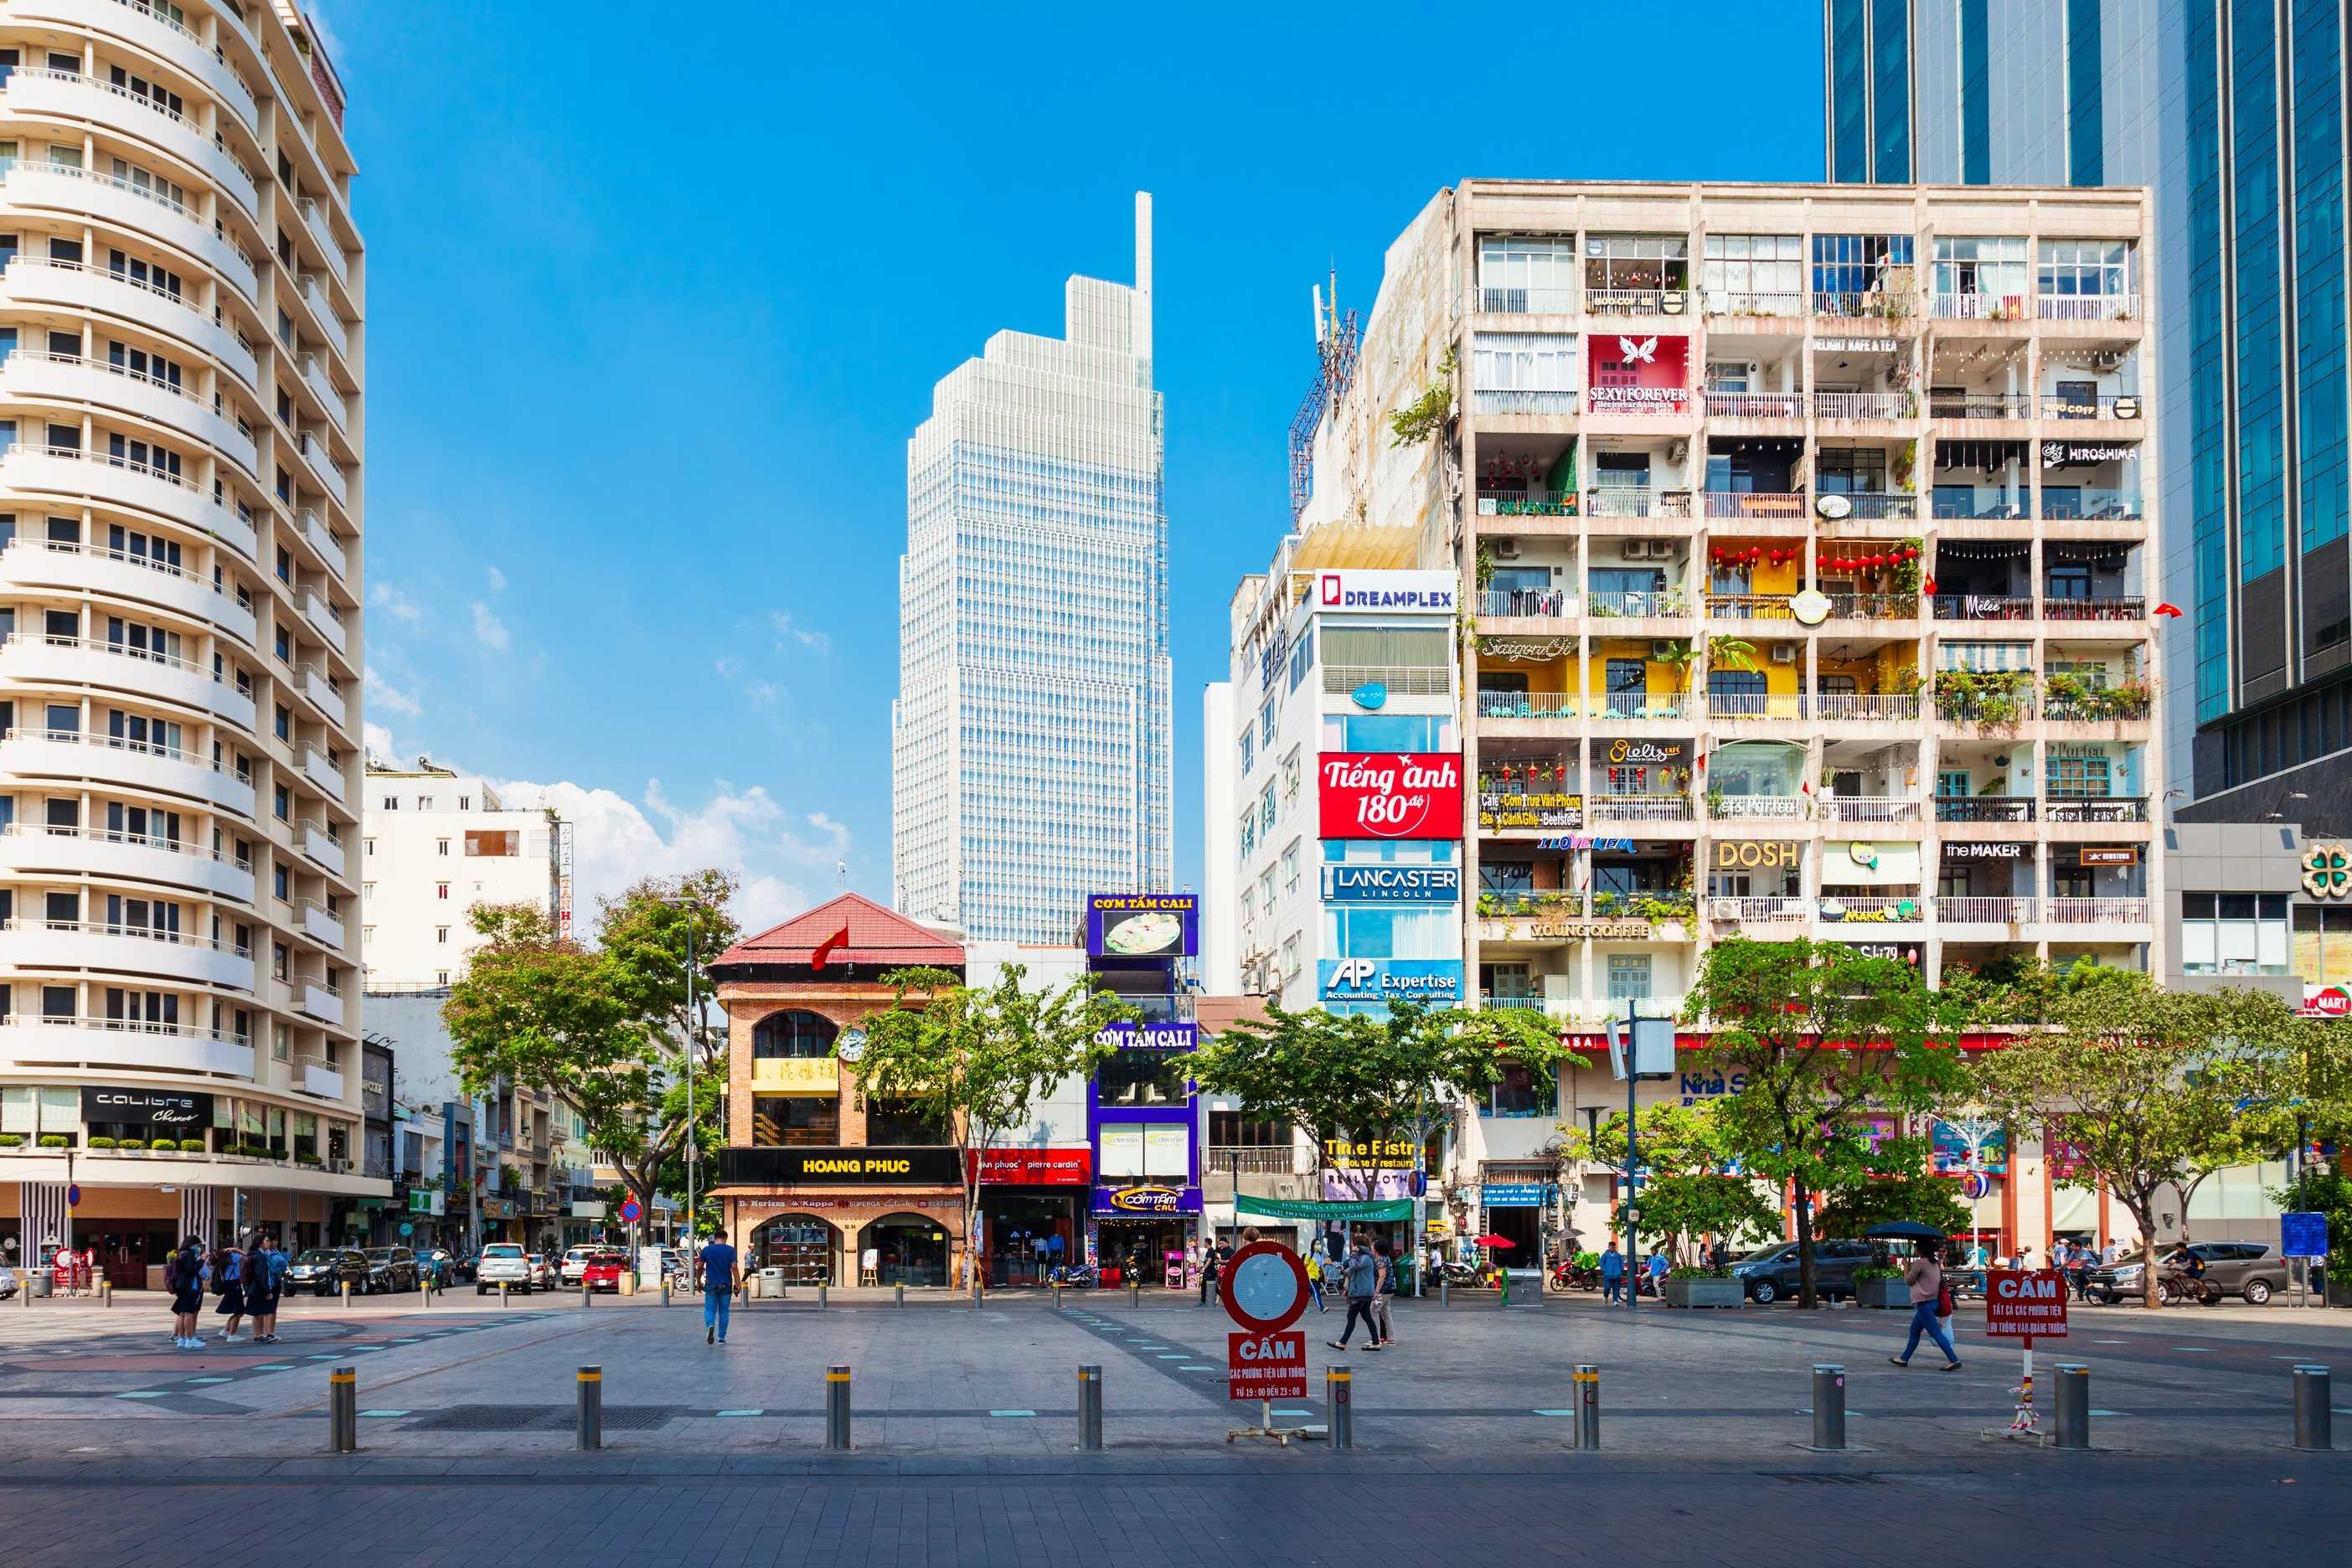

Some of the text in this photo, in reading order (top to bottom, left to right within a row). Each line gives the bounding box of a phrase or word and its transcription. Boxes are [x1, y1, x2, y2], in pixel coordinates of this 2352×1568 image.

[1591, 387, 1687, 402] SEXY FOREVER
[2070, 448, 2138, 461] HIROSHIMA
[1345, 591, 1452, 607] DREAMPLEX
[1324, 756, 1395, 796] Tiếng
[1357, 794, 1407, 823] 180
[1550, 835, 1591, 850] LOVE
[1592, 837, 1638, 854] KEM
[1946, 843, 2020, 857] the MAKER
[1719, 842, 1798, 867] DOSH
[1338, 869, 1457, 888] LANCASTER
[1093, 895, 1193, 910] CƠM TẤM CALI
[1531, 924, 1649, 938] YOUNG COFFEE
[1382, 972, 1456, 990] Expertise
[1326, 991, 1378, 1000] Accounting
[1406, 991, 1456, 1000] Conulting
[2318, 997, 2346, 1009] MART
[1157, 1029, 1192, 1047] CALI
[802, 1159, 910, 1173] HOANG PHUC
[1028, 1160, 1051, 1170] pierre
[1053, 1160, 1079, 1168] cardin
[1380, 1159, 1416, 1168] restaura
[1999, 1271, 2056, 1298] CẤM
[1240, 1333, 1296, 1360] CẤM
